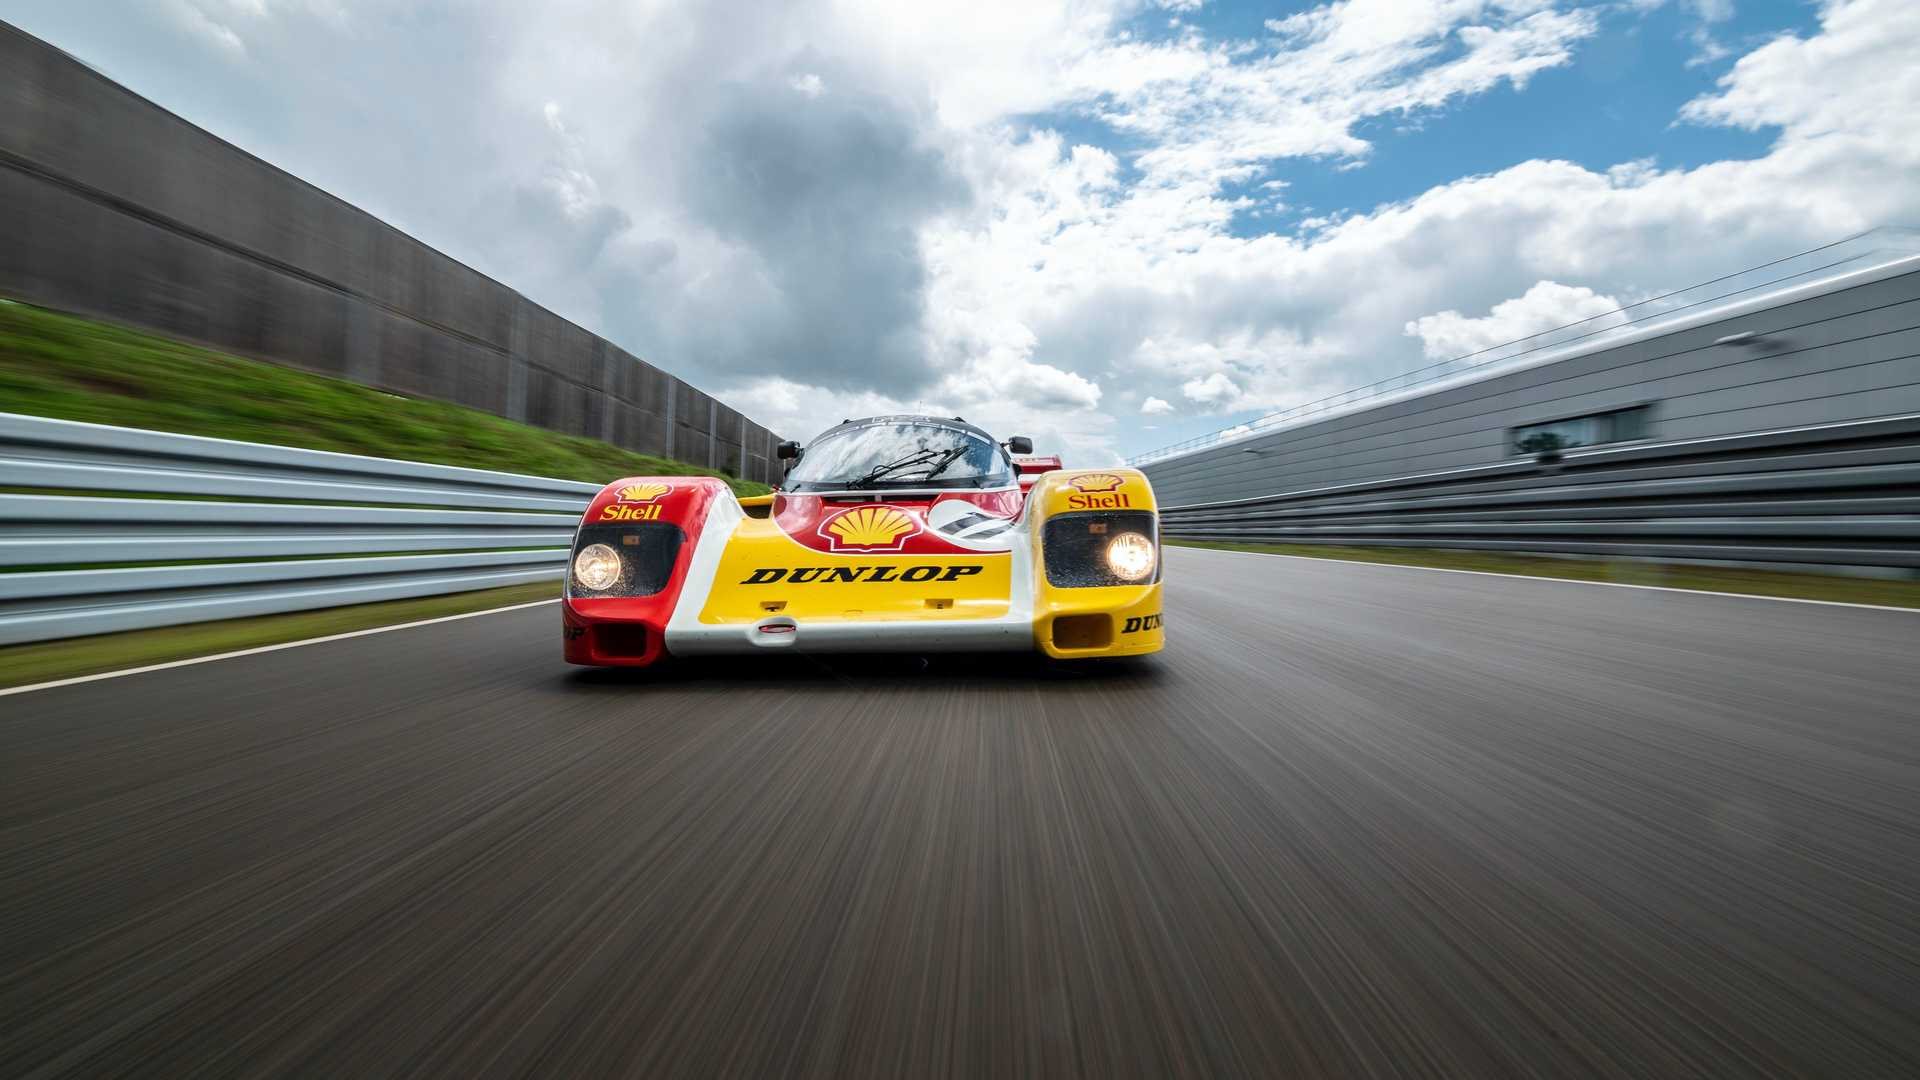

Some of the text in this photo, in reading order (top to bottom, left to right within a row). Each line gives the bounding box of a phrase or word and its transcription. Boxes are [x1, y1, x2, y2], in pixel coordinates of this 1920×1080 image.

[1068, 494, 1129, 509] Shell
[600, 505, 662, 520] Shell
[740, 566, 983, 584] DUNLOP
